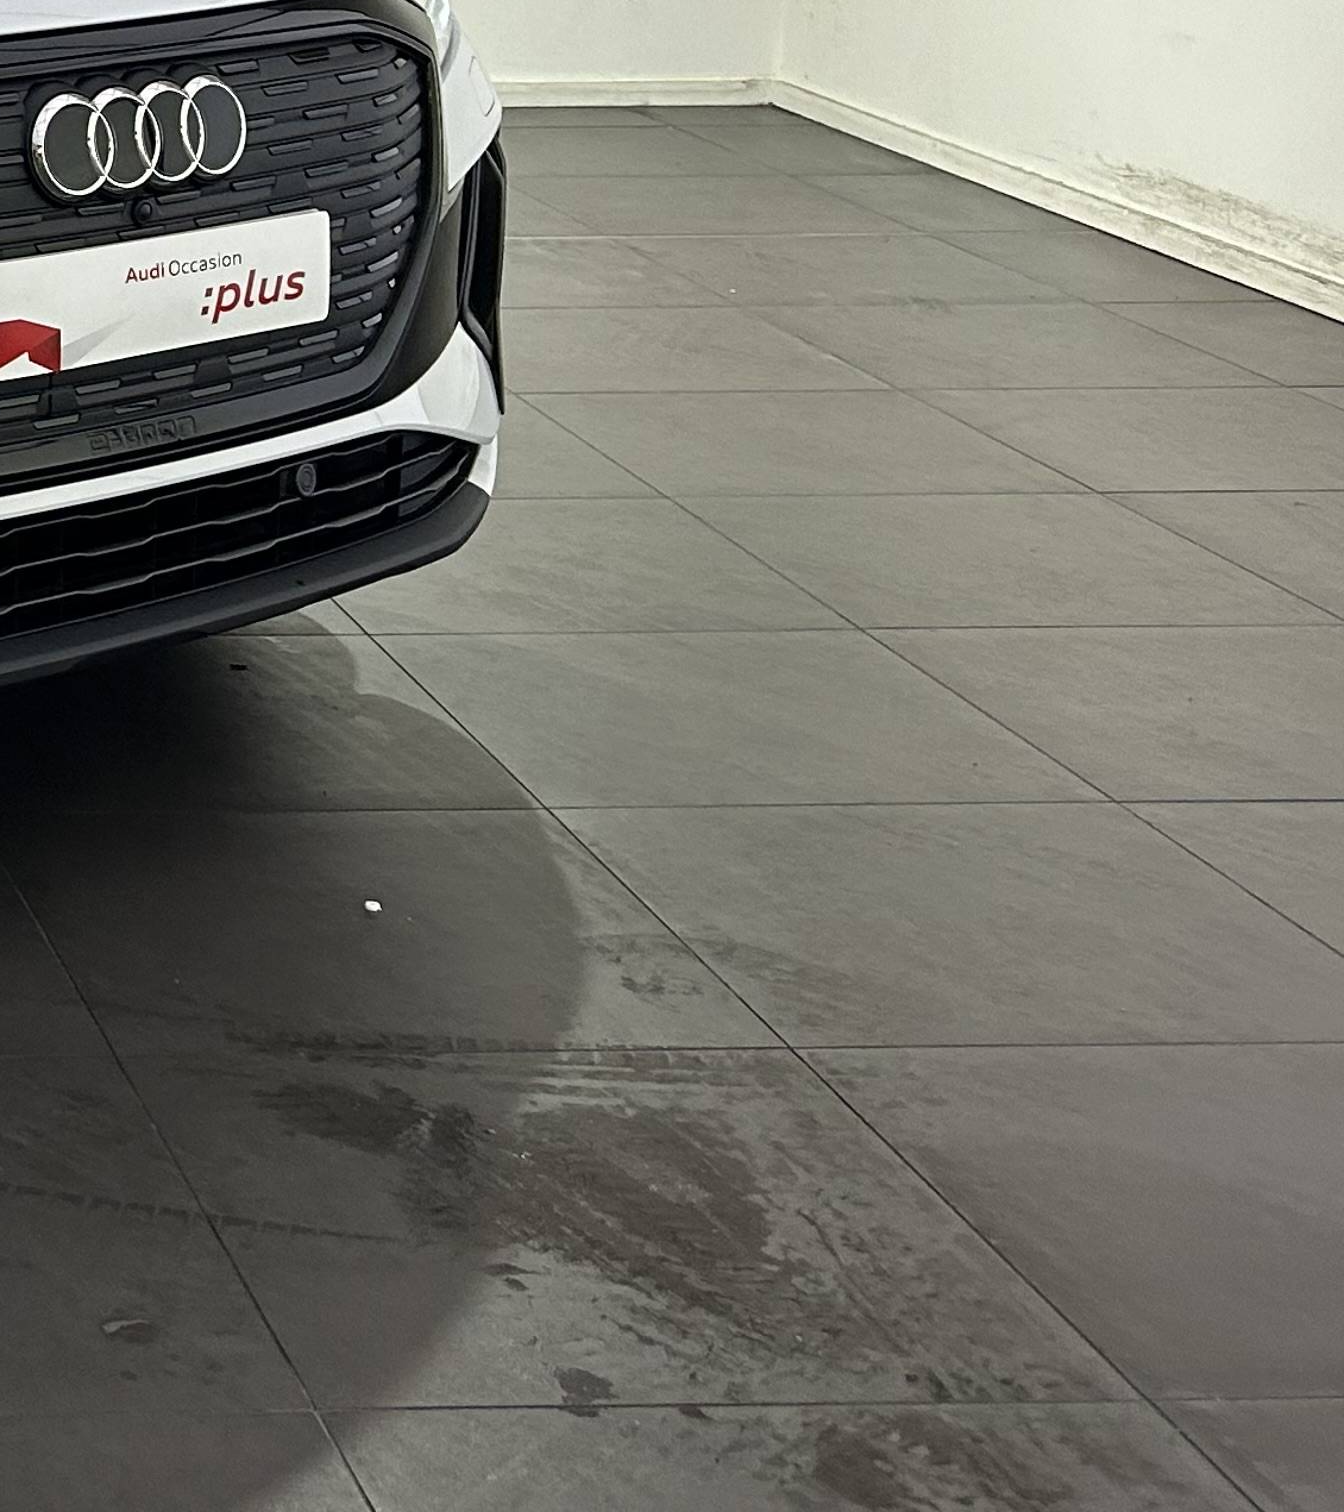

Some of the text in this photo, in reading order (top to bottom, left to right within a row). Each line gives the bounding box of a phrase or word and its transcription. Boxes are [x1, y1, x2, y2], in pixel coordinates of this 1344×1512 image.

[125, 253, 242, 284] Audi Occasion
[200, 269, 306, 324] :plus
